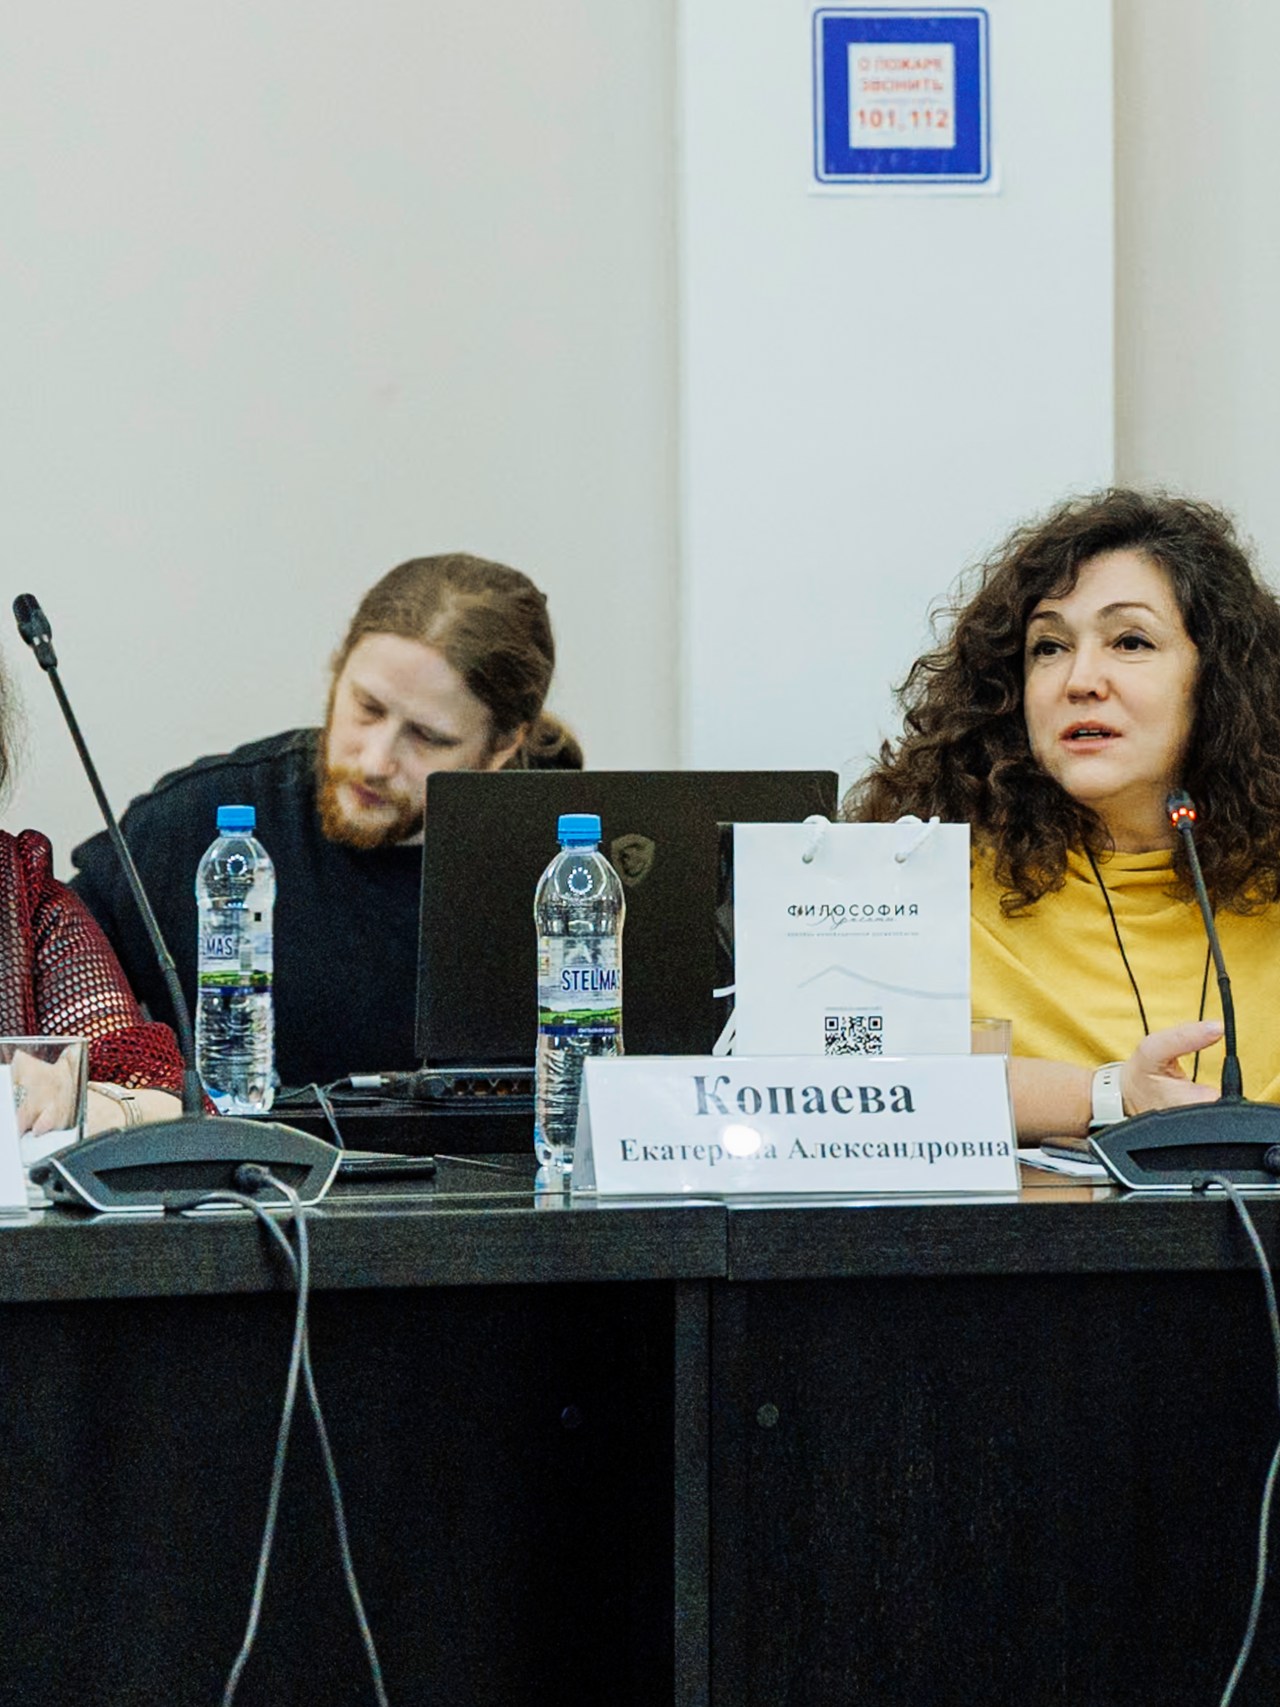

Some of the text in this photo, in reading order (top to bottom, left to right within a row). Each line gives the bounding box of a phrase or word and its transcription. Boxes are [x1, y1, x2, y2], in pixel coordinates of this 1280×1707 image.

[857, 57, 943, 73] О ПОЖАРЕ
[862, 79, 944, 93] ЗВОНИТЬ
[787, 903, 919, 917] ФИЛОСОФИЯ
[691, 1075, 916, 1116] Копаева
[619, 1137, 1010, 1167] Екатера Александровна
